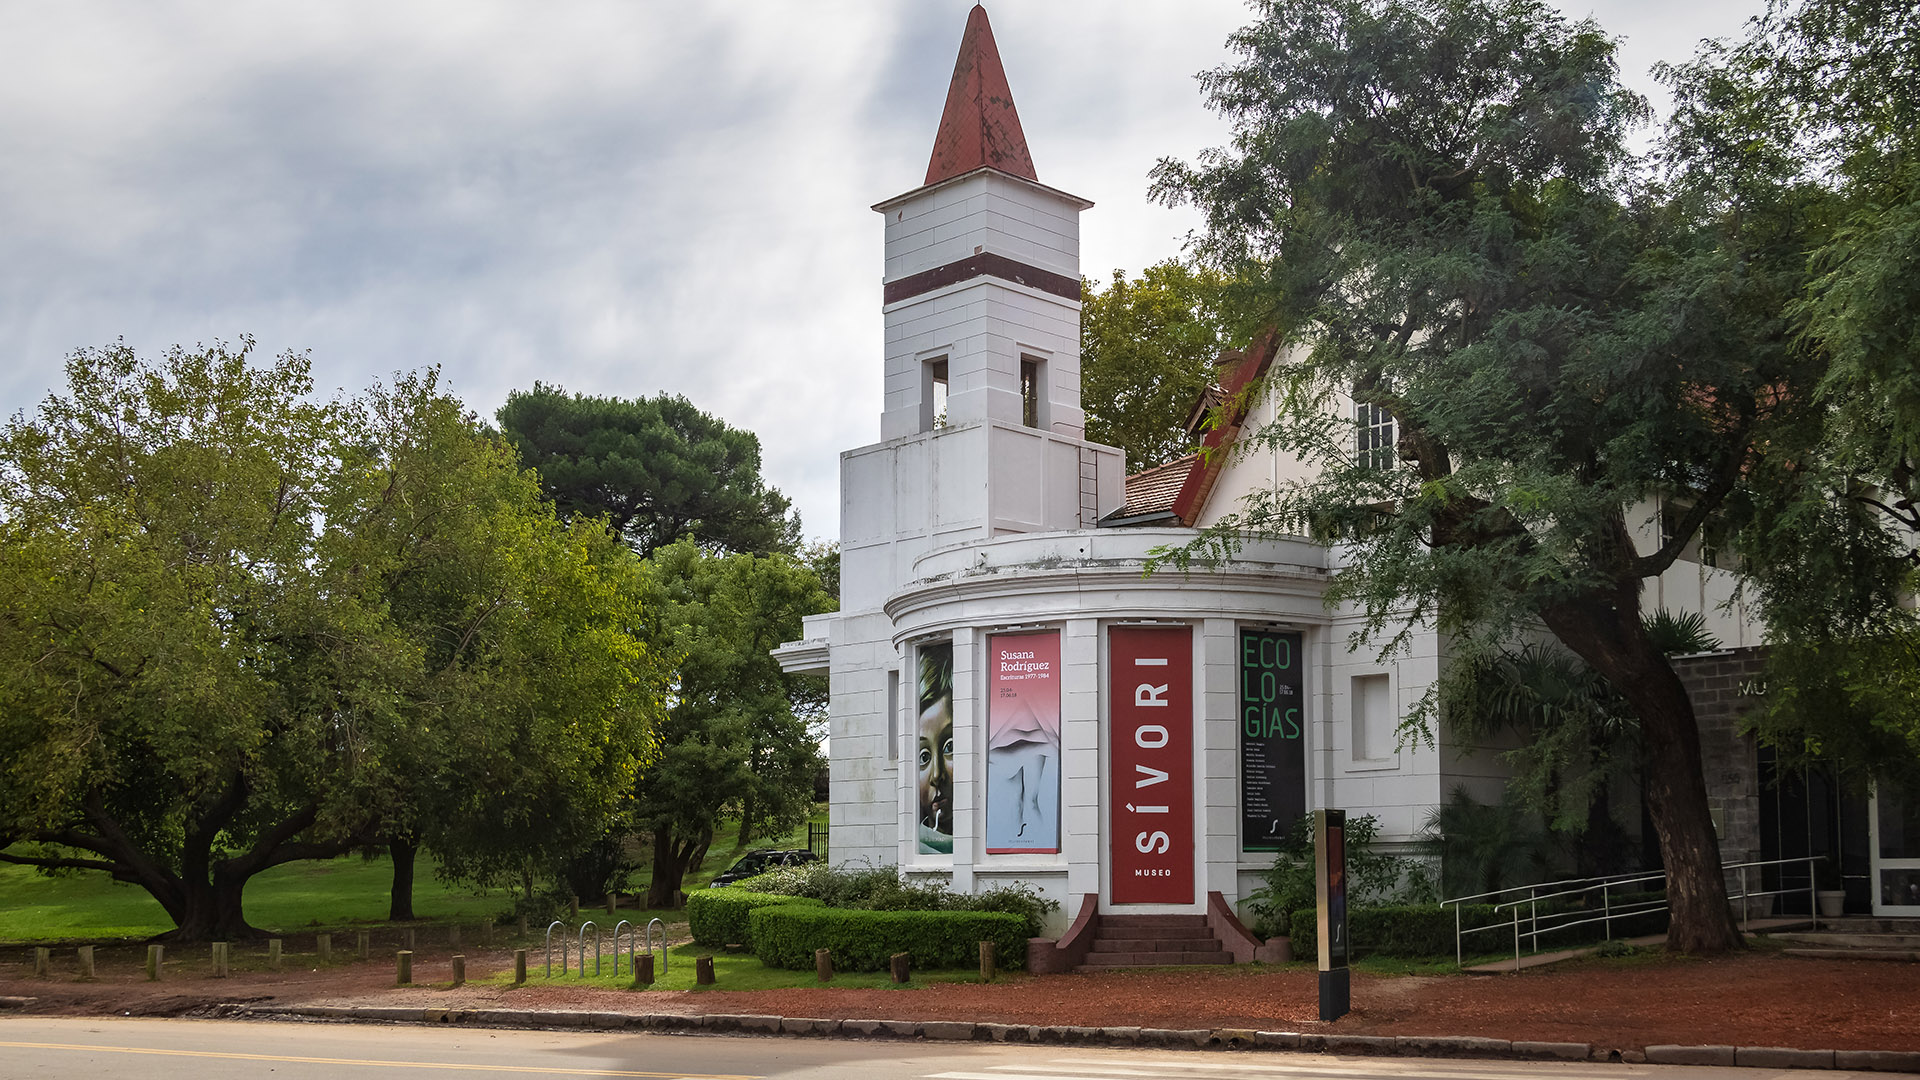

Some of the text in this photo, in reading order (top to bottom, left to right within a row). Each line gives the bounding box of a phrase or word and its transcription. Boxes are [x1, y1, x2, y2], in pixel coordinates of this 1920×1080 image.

[1000, 650, 1034, 660] Susana
[1000, 661, 1049, 672] Rodríguez
[1244, 635, 1290, 669] ECO
[1244, 670, 1276, 703] LO
[1245, 703, 1300, 739] GÍAS
[1125, 658, 1170, 855] SÍVORI
[1135, 869, 1171, 877] MUSEO
